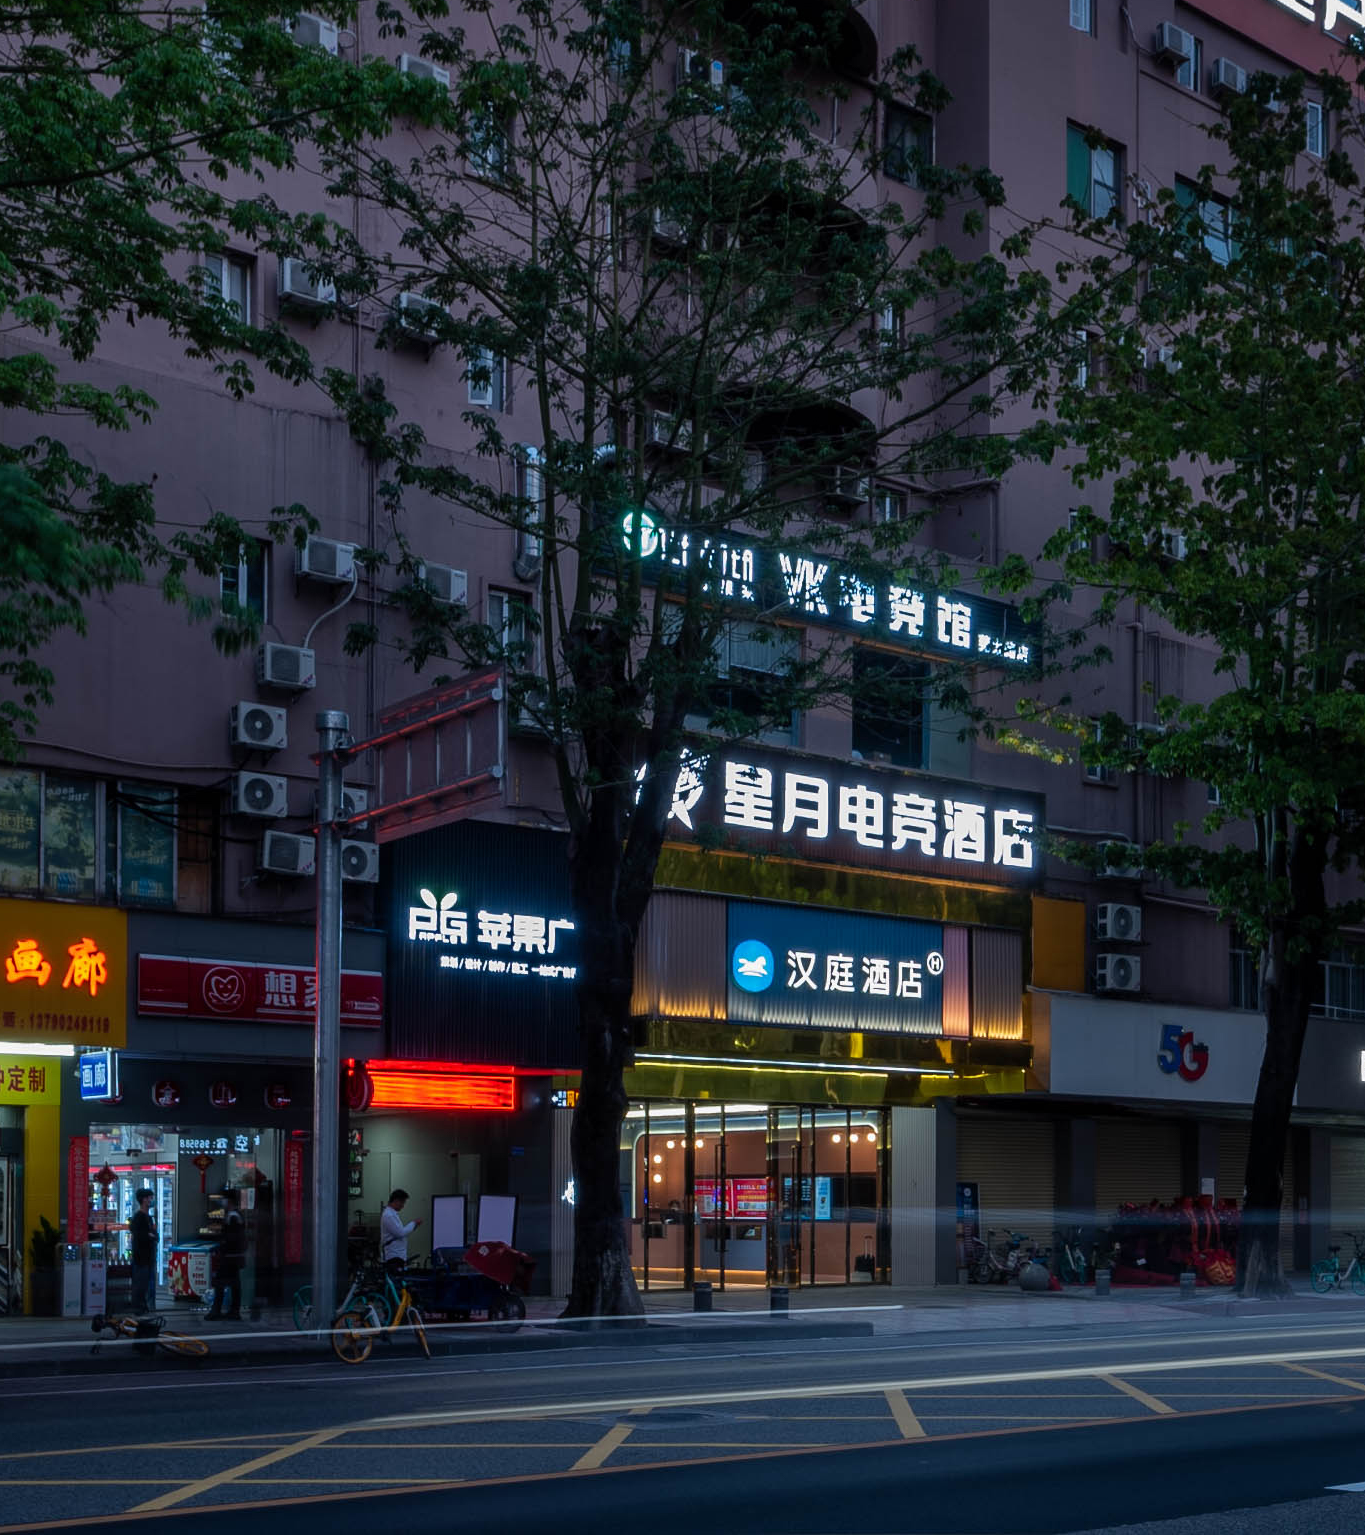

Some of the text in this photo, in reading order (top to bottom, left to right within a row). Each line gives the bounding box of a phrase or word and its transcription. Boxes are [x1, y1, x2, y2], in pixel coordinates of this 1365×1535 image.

[724, 761, 1034, 868] 星月电竞酒店
[786, 949, 923, 999] 汉庭酒店
[81, 1062, 107, 1089] 画廊
[1157, 1025, 1209, 1082] 5G
